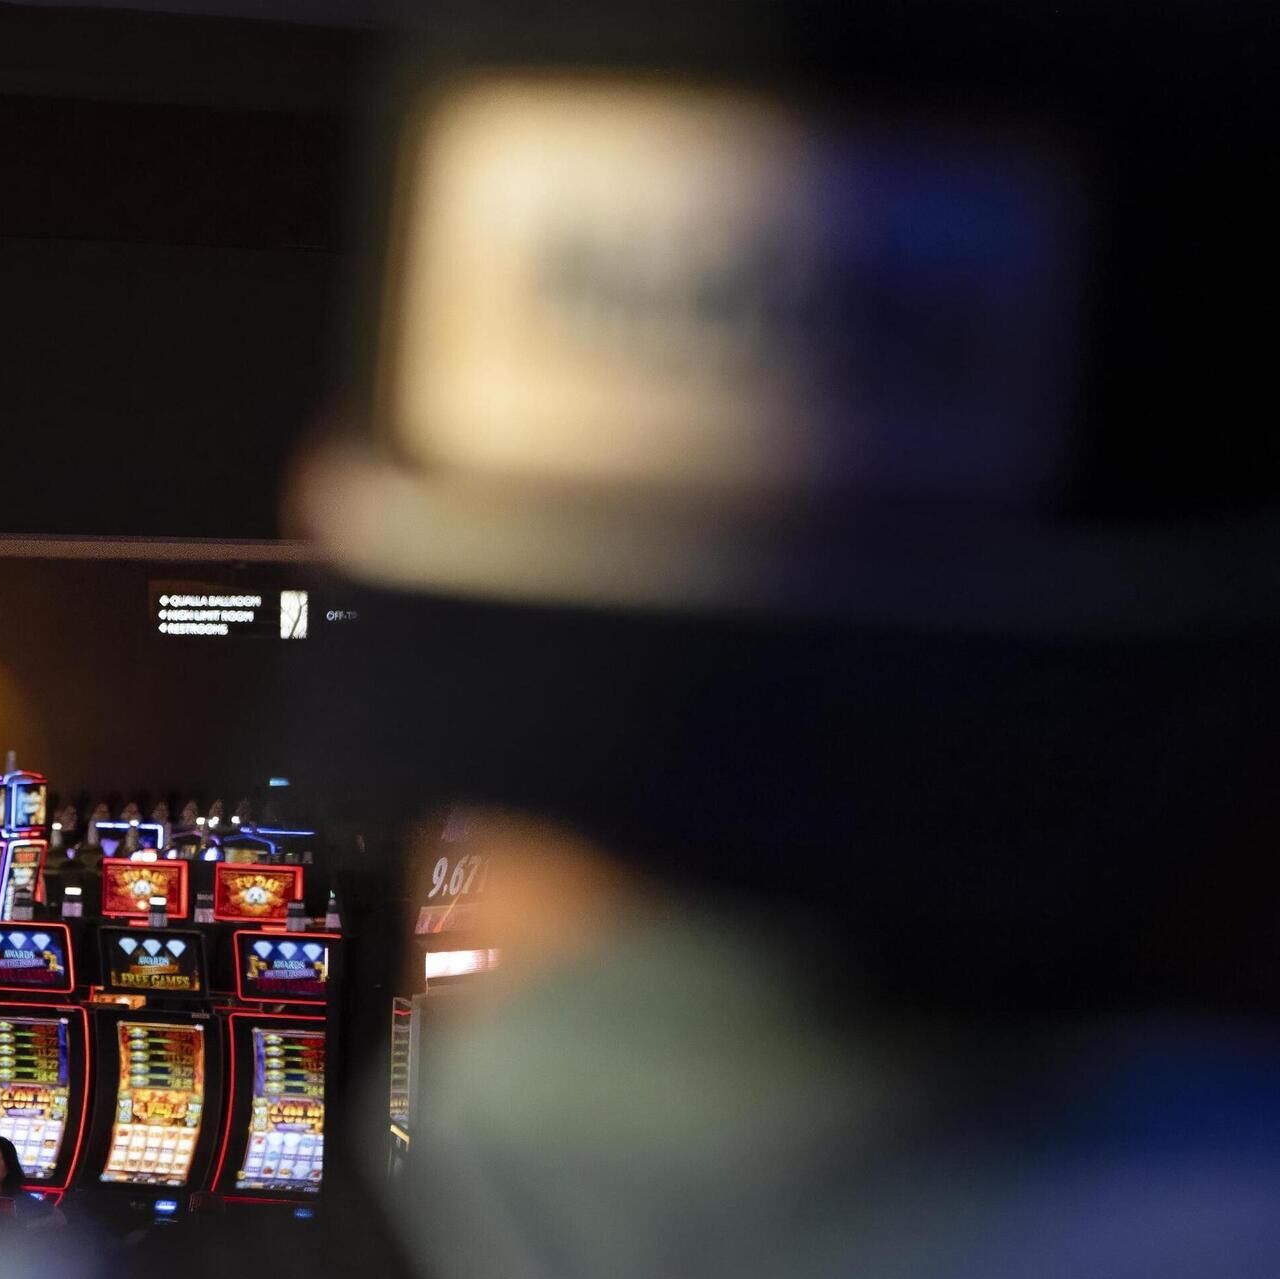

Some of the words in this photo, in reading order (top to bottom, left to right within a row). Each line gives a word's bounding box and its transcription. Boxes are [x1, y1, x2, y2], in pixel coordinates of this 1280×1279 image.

[221, 611, 254, 621] ROOM
[121, 973, 149, 985] FREE
[151, 975, 190, 987] GAMES
